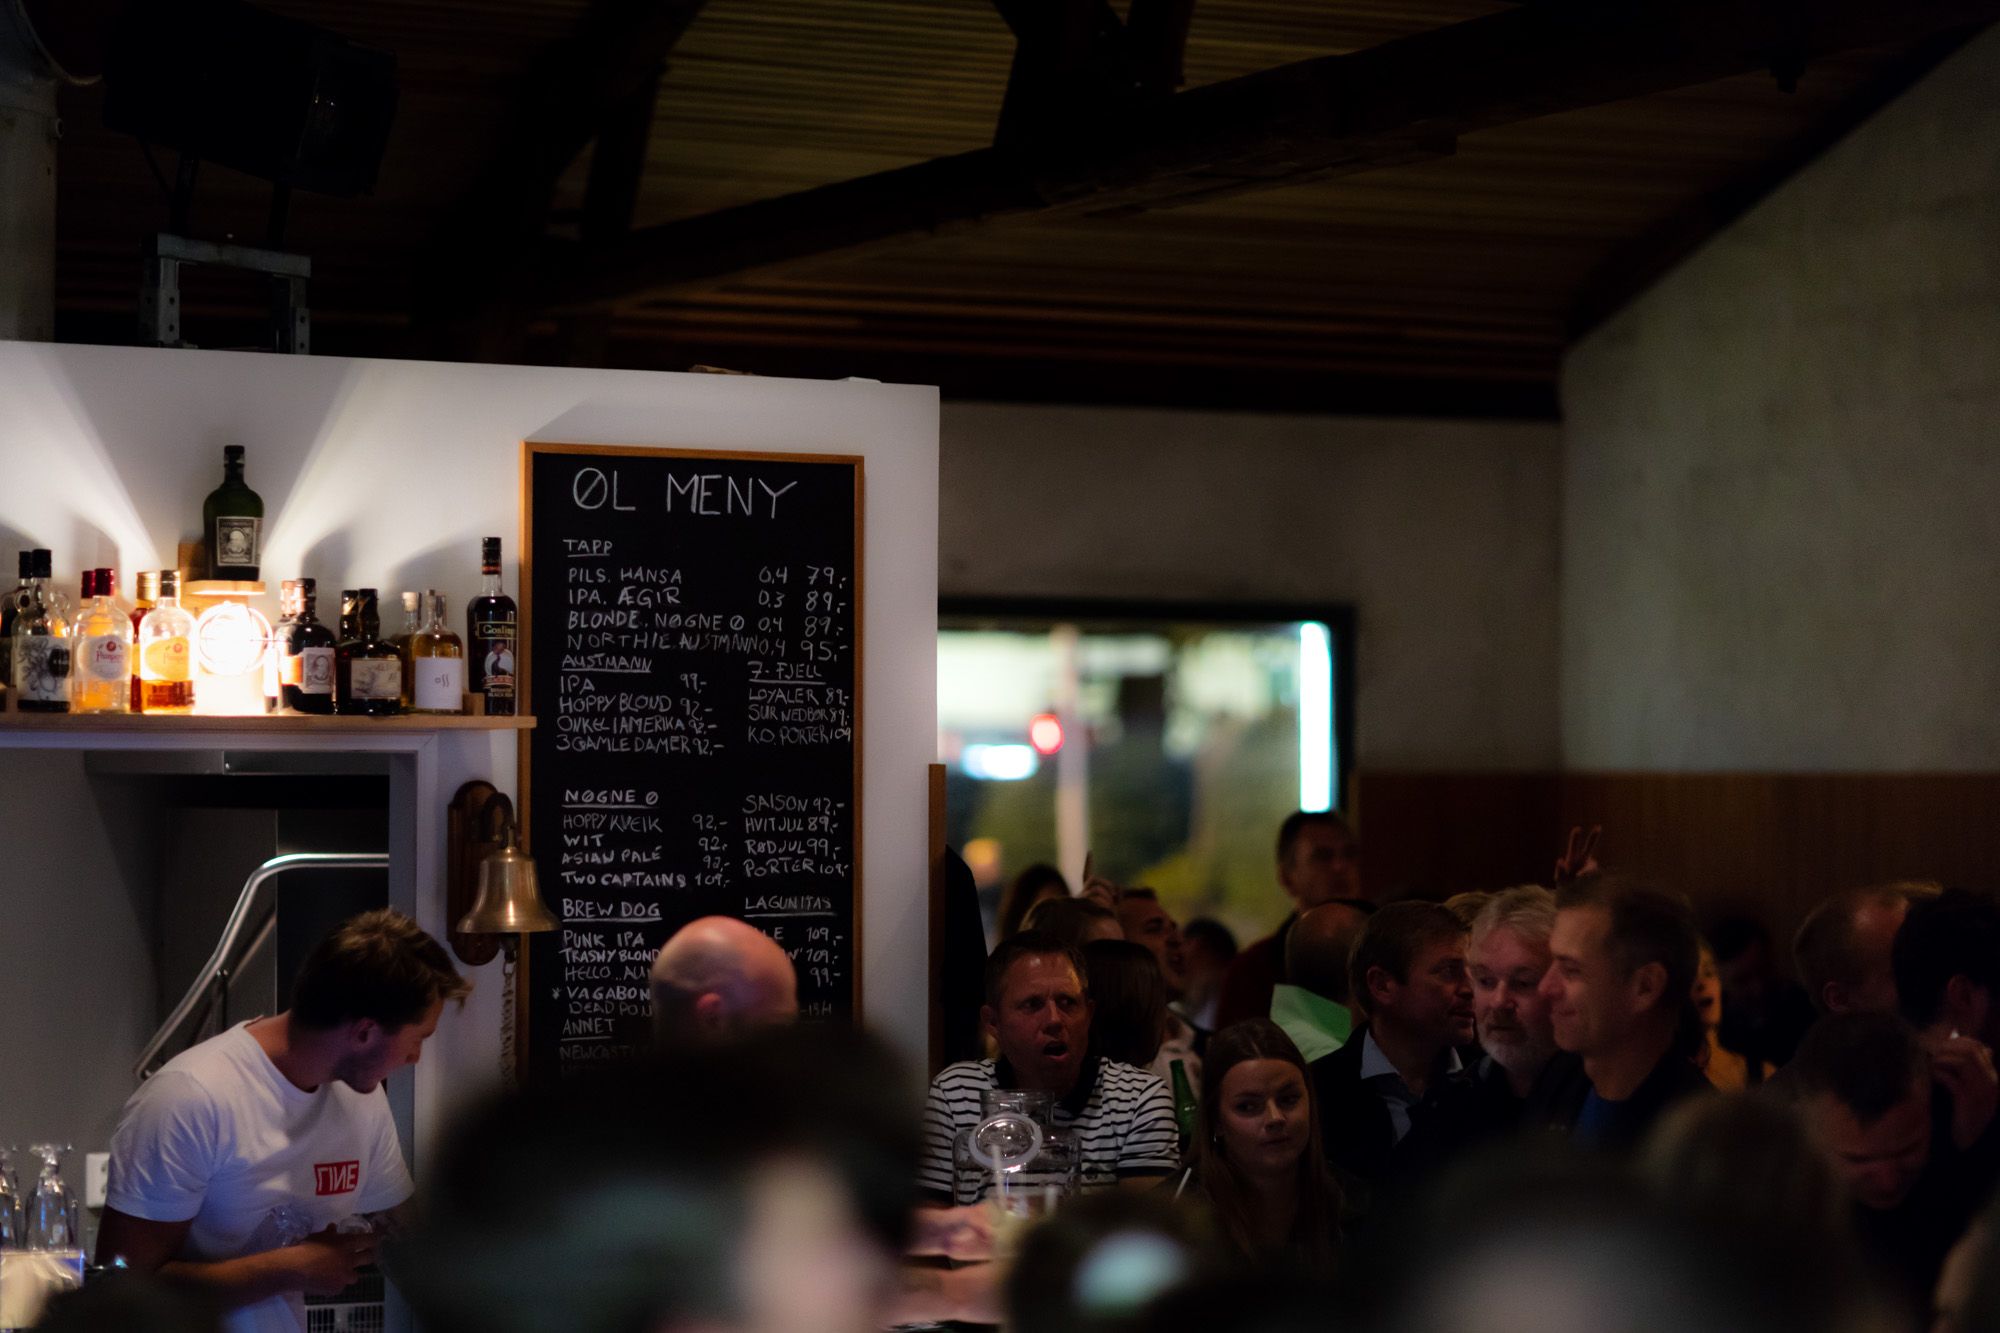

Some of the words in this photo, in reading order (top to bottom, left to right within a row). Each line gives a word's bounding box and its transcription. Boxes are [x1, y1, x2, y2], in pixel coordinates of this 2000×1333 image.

[573, 467, 636, 511] ØL
[666, 473, 798, 519] MENY
[563, 539, 613, 554] TAPP
[620, 566, 682, 584] HANSA
[617, 586, 681, 608] ÆGIR
[655, 612, 723, 630] NØGNE
[561, 653, 652, 671] AUSTMANN
[560, 675, 596, 695] IPA
[559, 695, 617, 713] HOPPY
[749, 687, 820, 705] LOYALER
[748, 704, 779, 721] SUR
[619, 714, 686, 734] AMERIKA
[634, 735, 691, 753] DAMER
[779, 724, 830, 746] PORTER
[565, 789, 636, 804] NØGNE
[645, 791, 660, 806] Ø
[742, 793, 808, 814] SAISON
[562, 813, 608, 831] HOPPY
[609, 815, 664, 833] KVEIK
[563, 833, 605, 847] WIT
[742, 856, 816, 878] PORTER
[601, 872, 687, 888] CAPTAINS
[562, 899, 613, 918] BREW
[621, 901, 661, 917] DOG
[744, 895, 833, 911] LAGUNITAS
[563, 929, 606, 949] PUNK
[616, 930, 646, 948] IPA
[618, 948, 661, 963] BLOND
[564, 964, 612, 982] HELLO
[566, 985, 652, 1001] VAGABON
[568, 1000, 615, 1015] DEAD
[561, 1018, 616, 1036] ANNET
